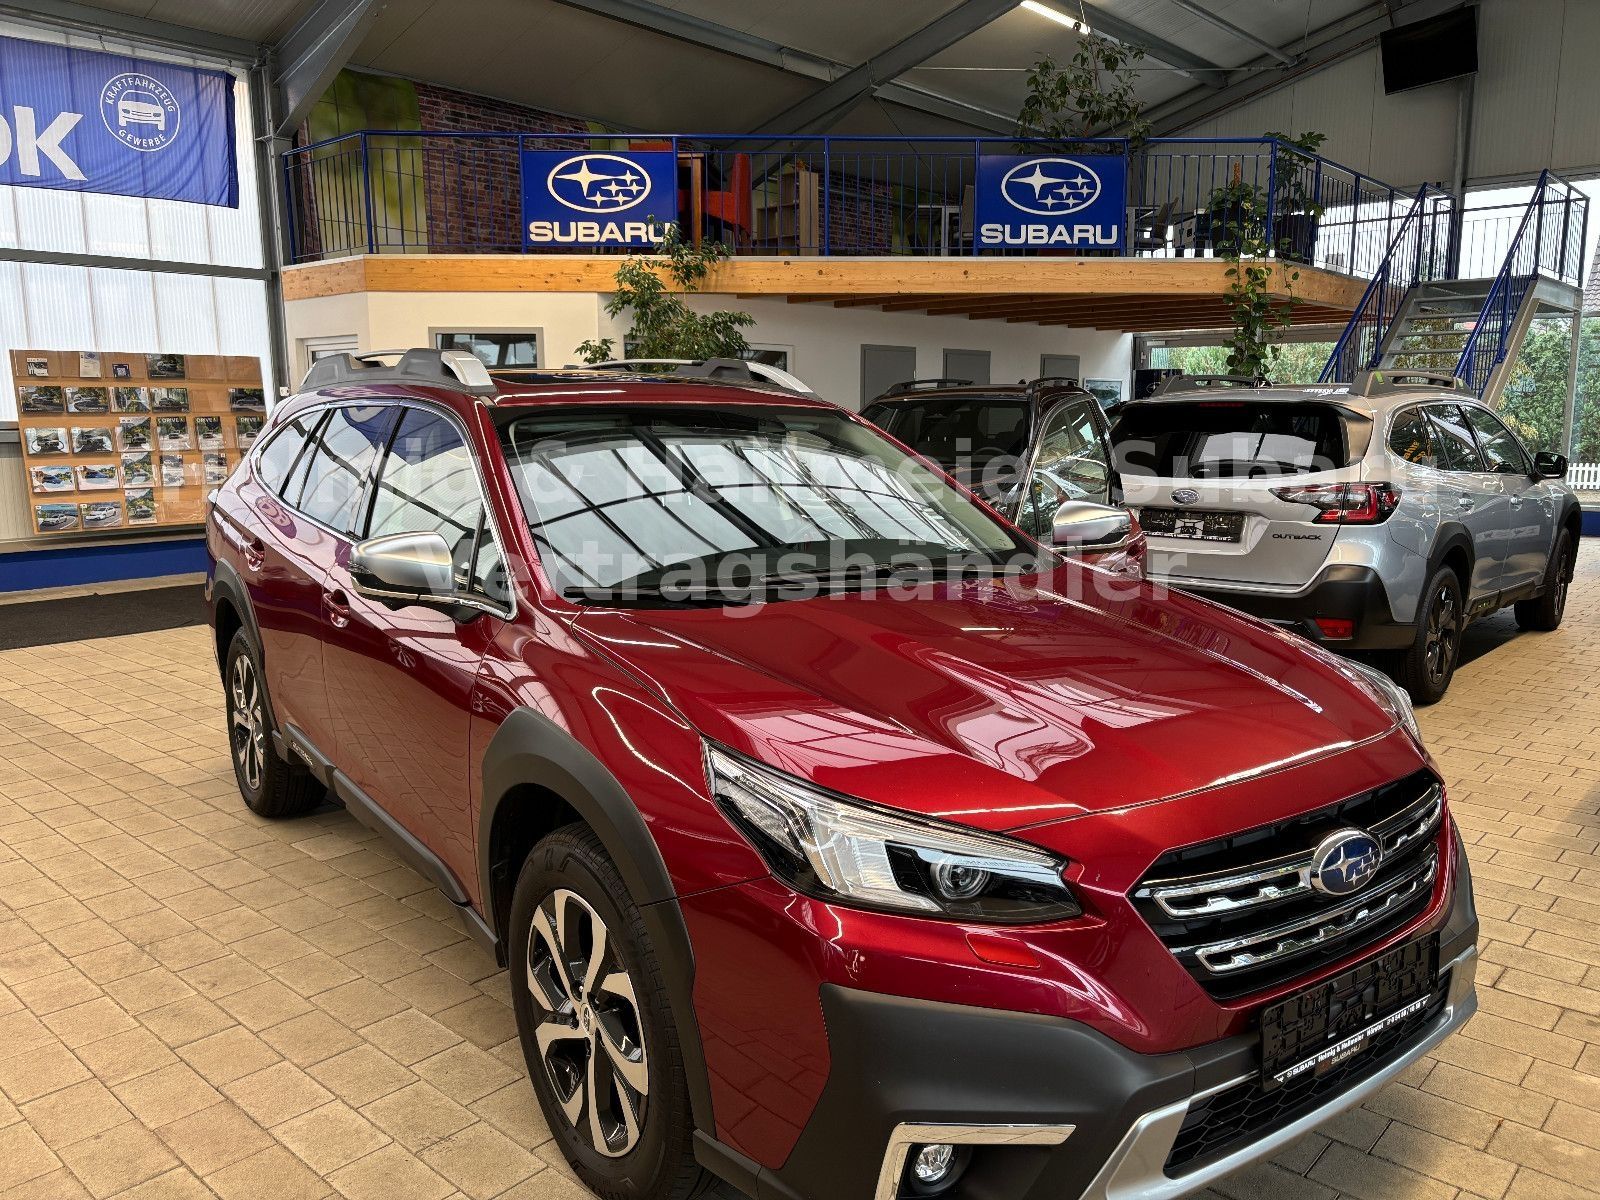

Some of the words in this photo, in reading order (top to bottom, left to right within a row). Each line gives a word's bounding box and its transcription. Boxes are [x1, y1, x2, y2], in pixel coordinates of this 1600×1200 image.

[105, 77, 176, 113] KRAFTFAHRZEUG
[0, 105, 88, 181] K
[118, 128, 167, 148] GEWERBE
[529, 221, 671, 243] SUBARU
[980, 223, 1118, 245] SUBARU
[1272, 533, 1322, 541] OUTBACK
[1331, 1043, 1361, 1065] SUBARU
[1292, 1058, 1316, 1076] SUBARU
